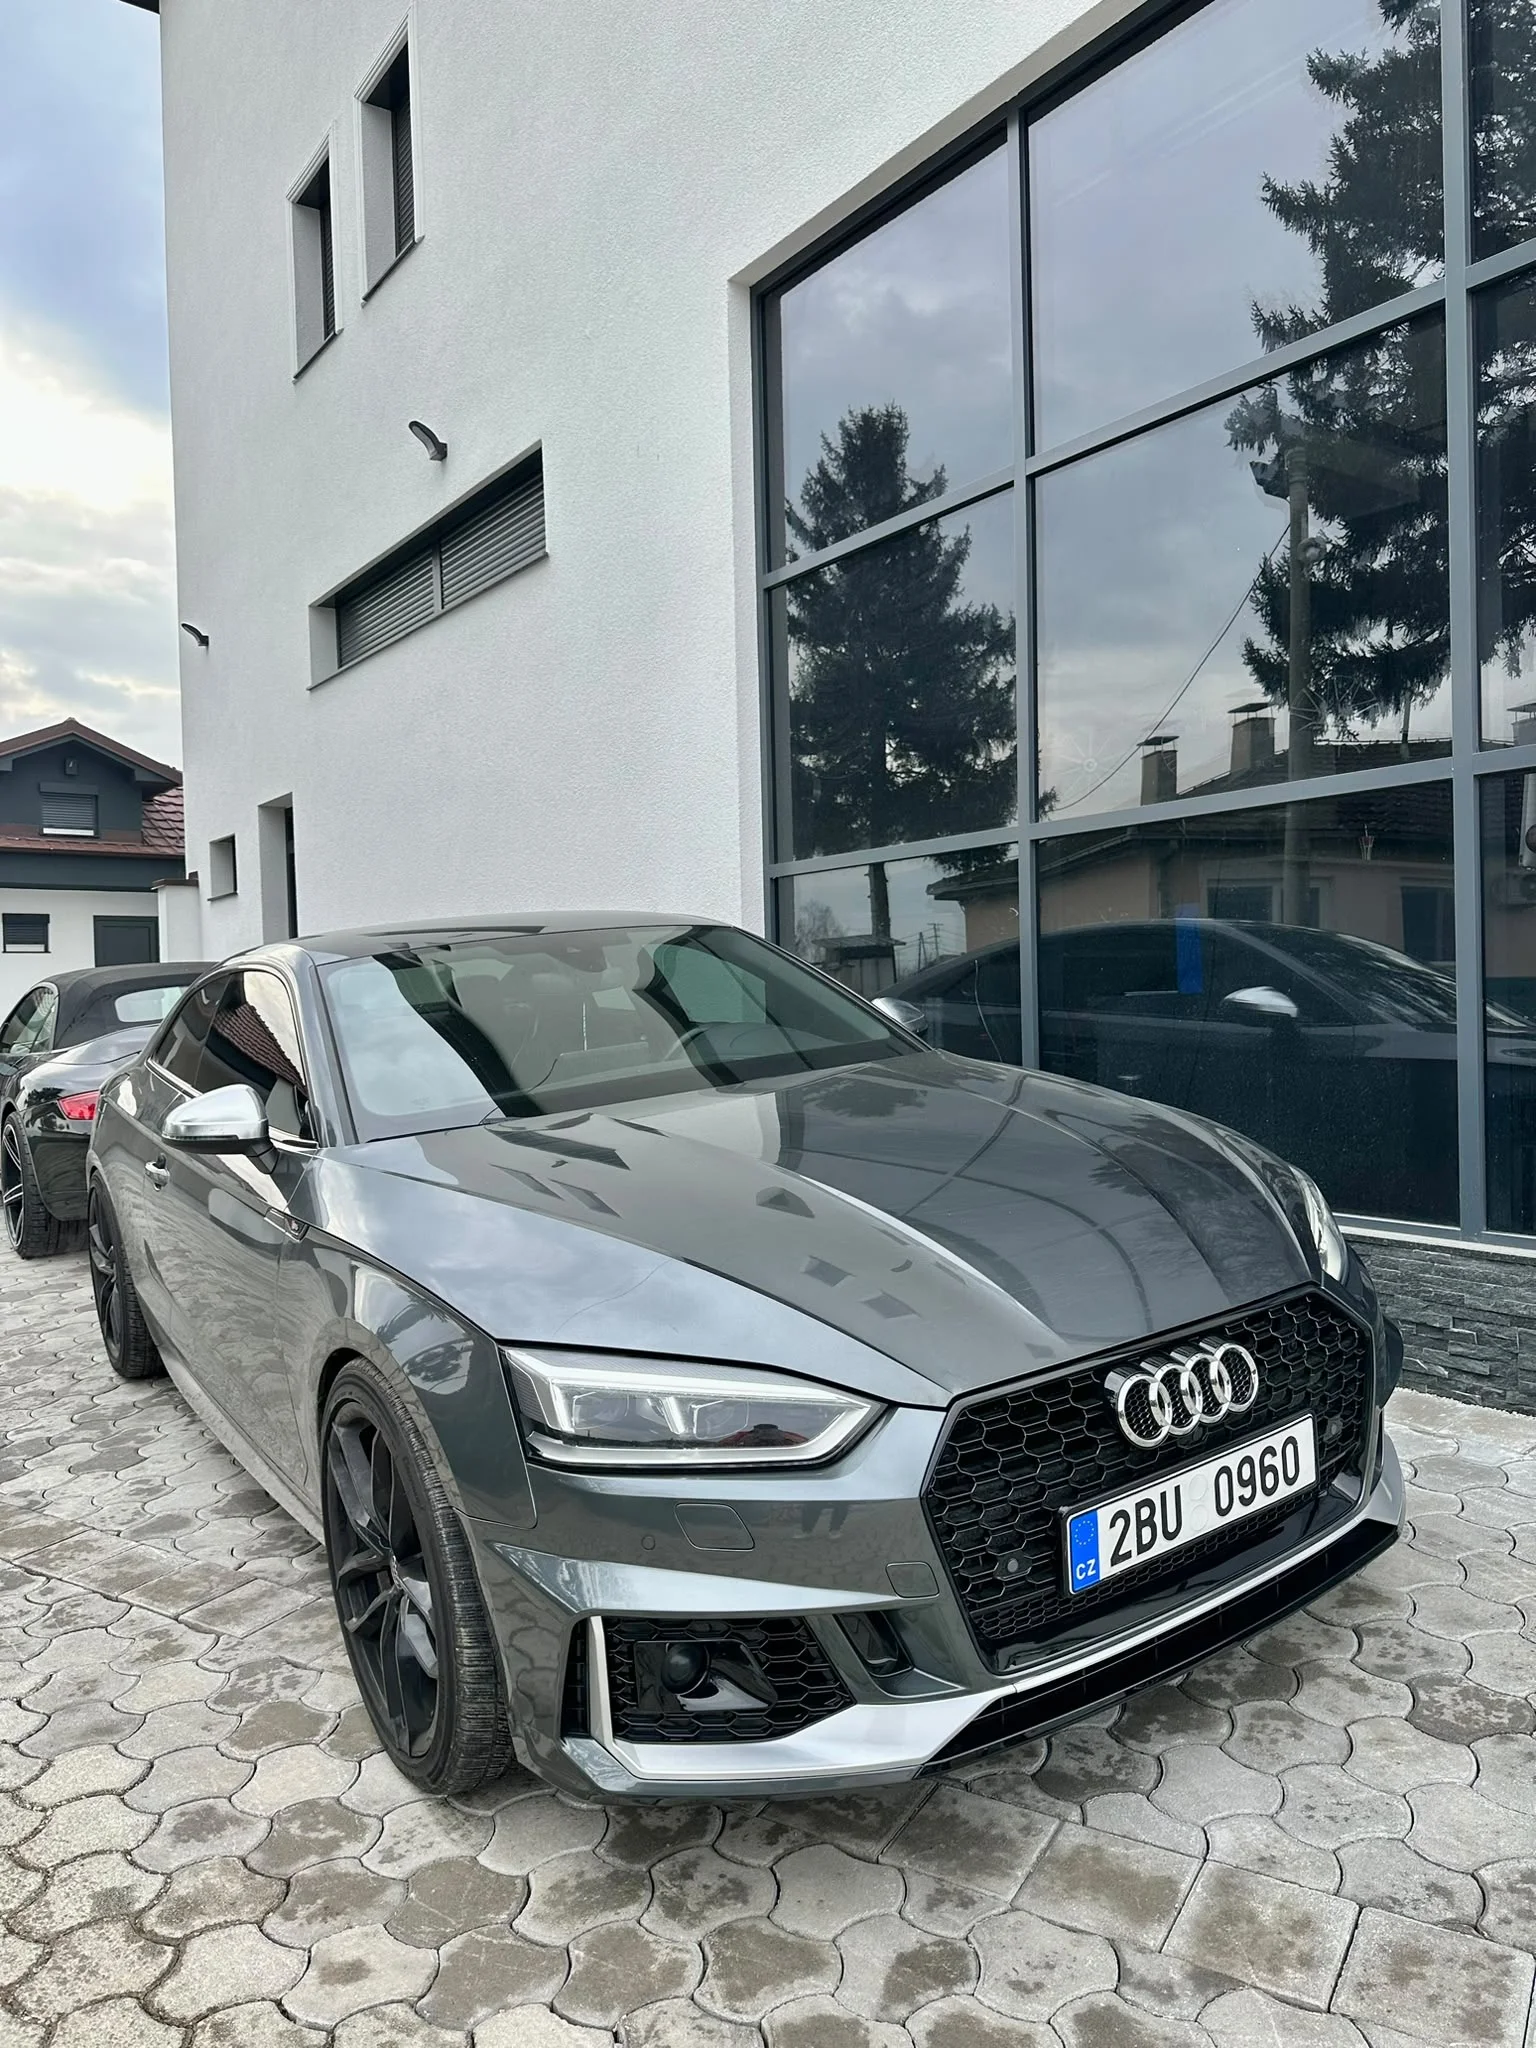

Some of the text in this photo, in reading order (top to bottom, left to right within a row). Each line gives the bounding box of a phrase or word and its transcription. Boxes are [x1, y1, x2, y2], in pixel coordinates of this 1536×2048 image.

[1109, 1436, 1300, 1568] 2BU 0960
[1076, 1558, 1097, 1580] CZ
